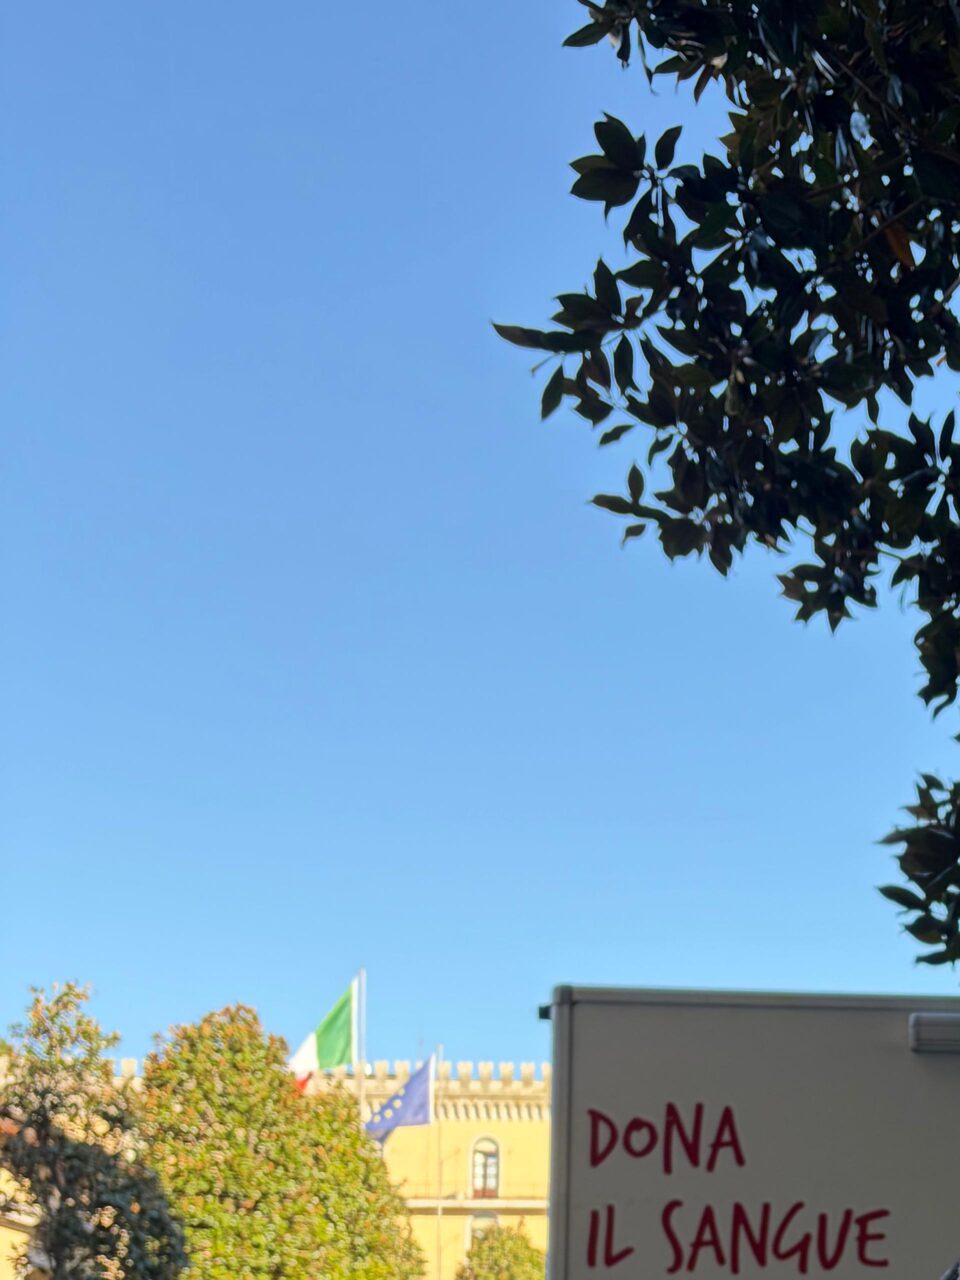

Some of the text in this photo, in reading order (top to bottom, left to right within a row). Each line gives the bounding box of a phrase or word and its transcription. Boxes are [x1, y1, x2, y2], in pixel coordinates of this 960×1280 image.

[587, 1102, 746, 1175] DONA
[586, 1199, 891, 1275] IL SANGUE
